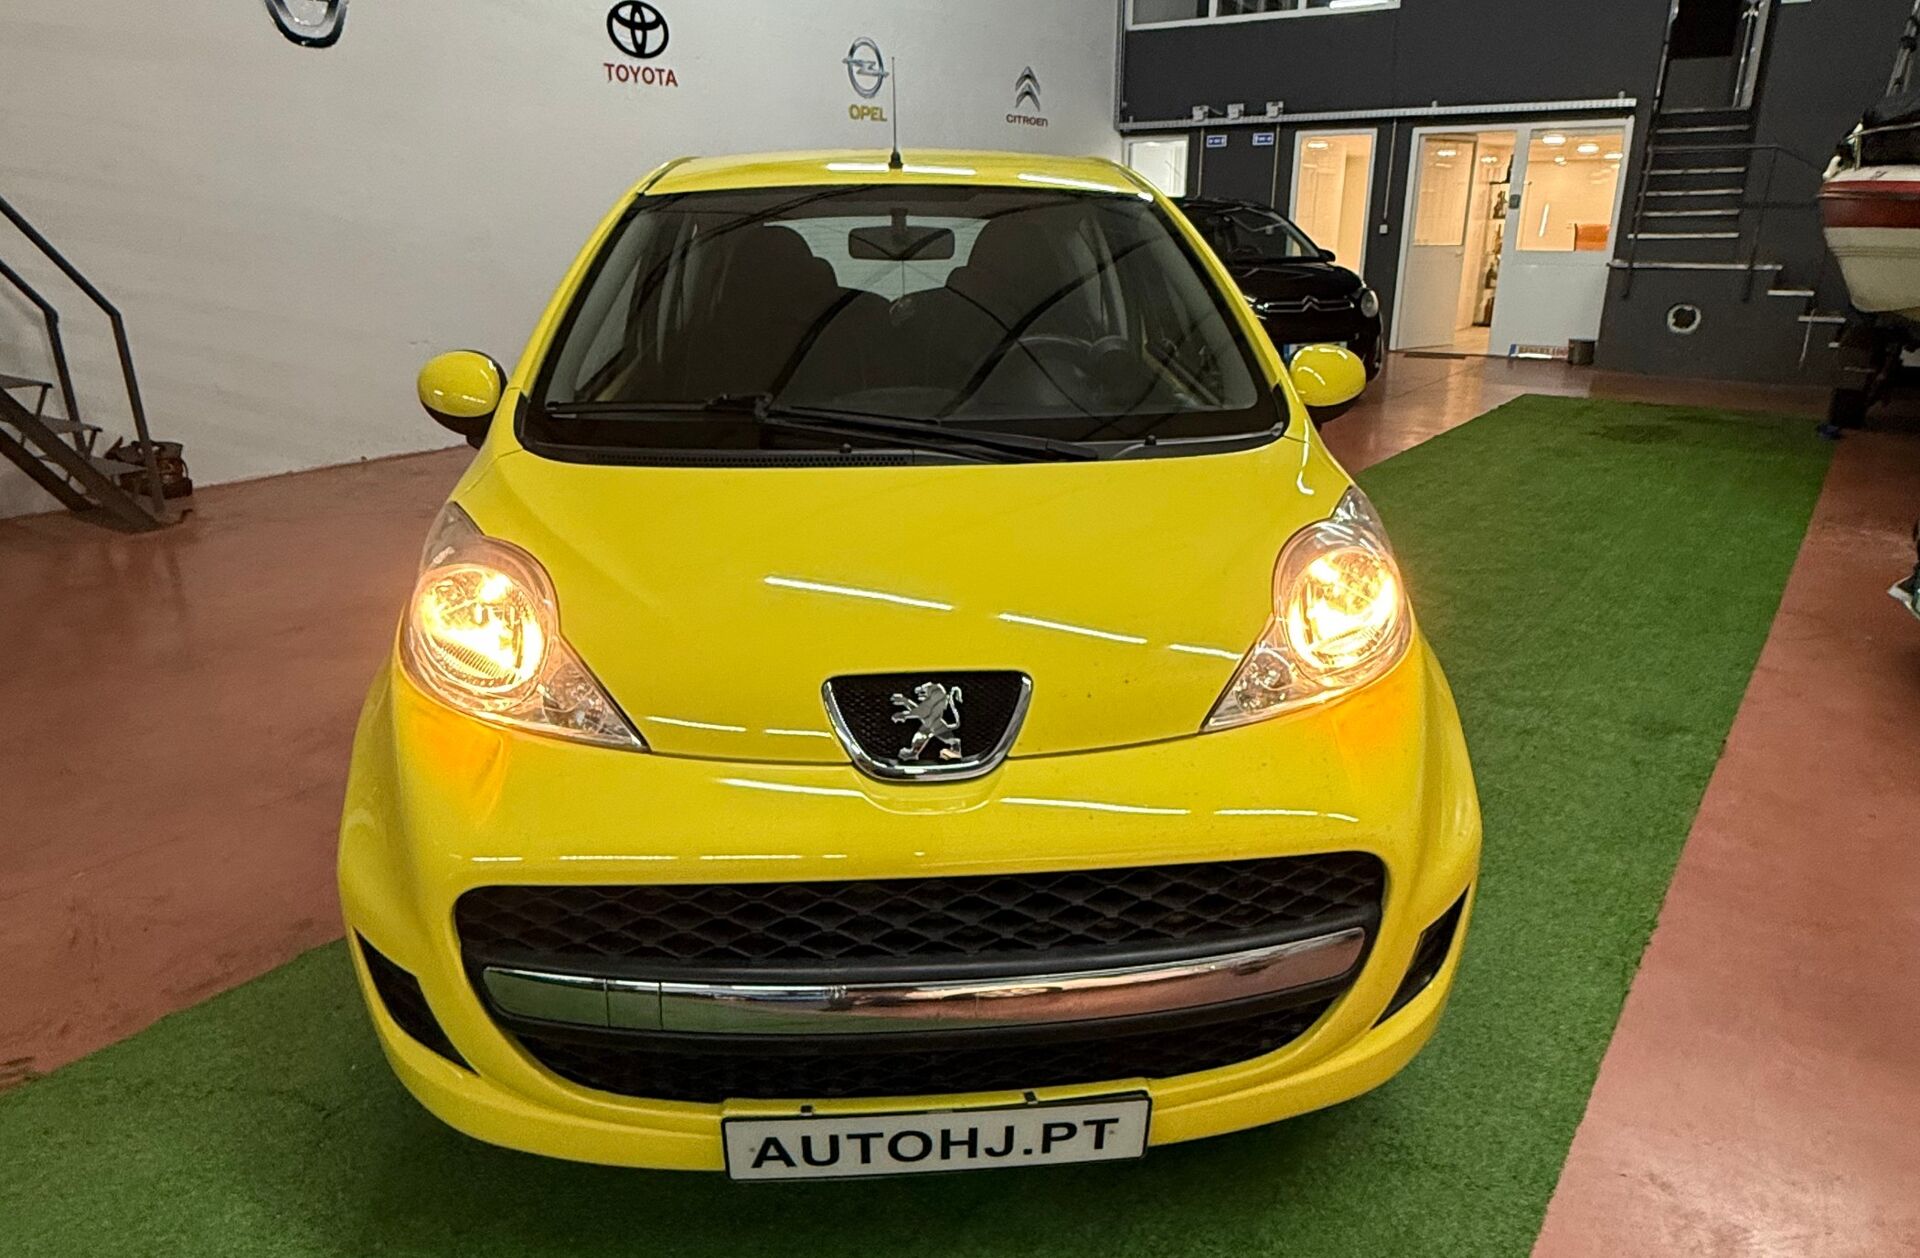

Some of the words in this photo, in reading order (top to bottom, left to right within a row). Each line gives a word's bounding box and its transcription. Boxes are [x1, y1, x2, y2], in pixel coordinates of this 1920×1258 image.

[603, 62, 678, 87] TOYOTA
[849, 104, 887, 122] OPEL
[751, 1117, 1119, 1169] AUTOHJ.PT
